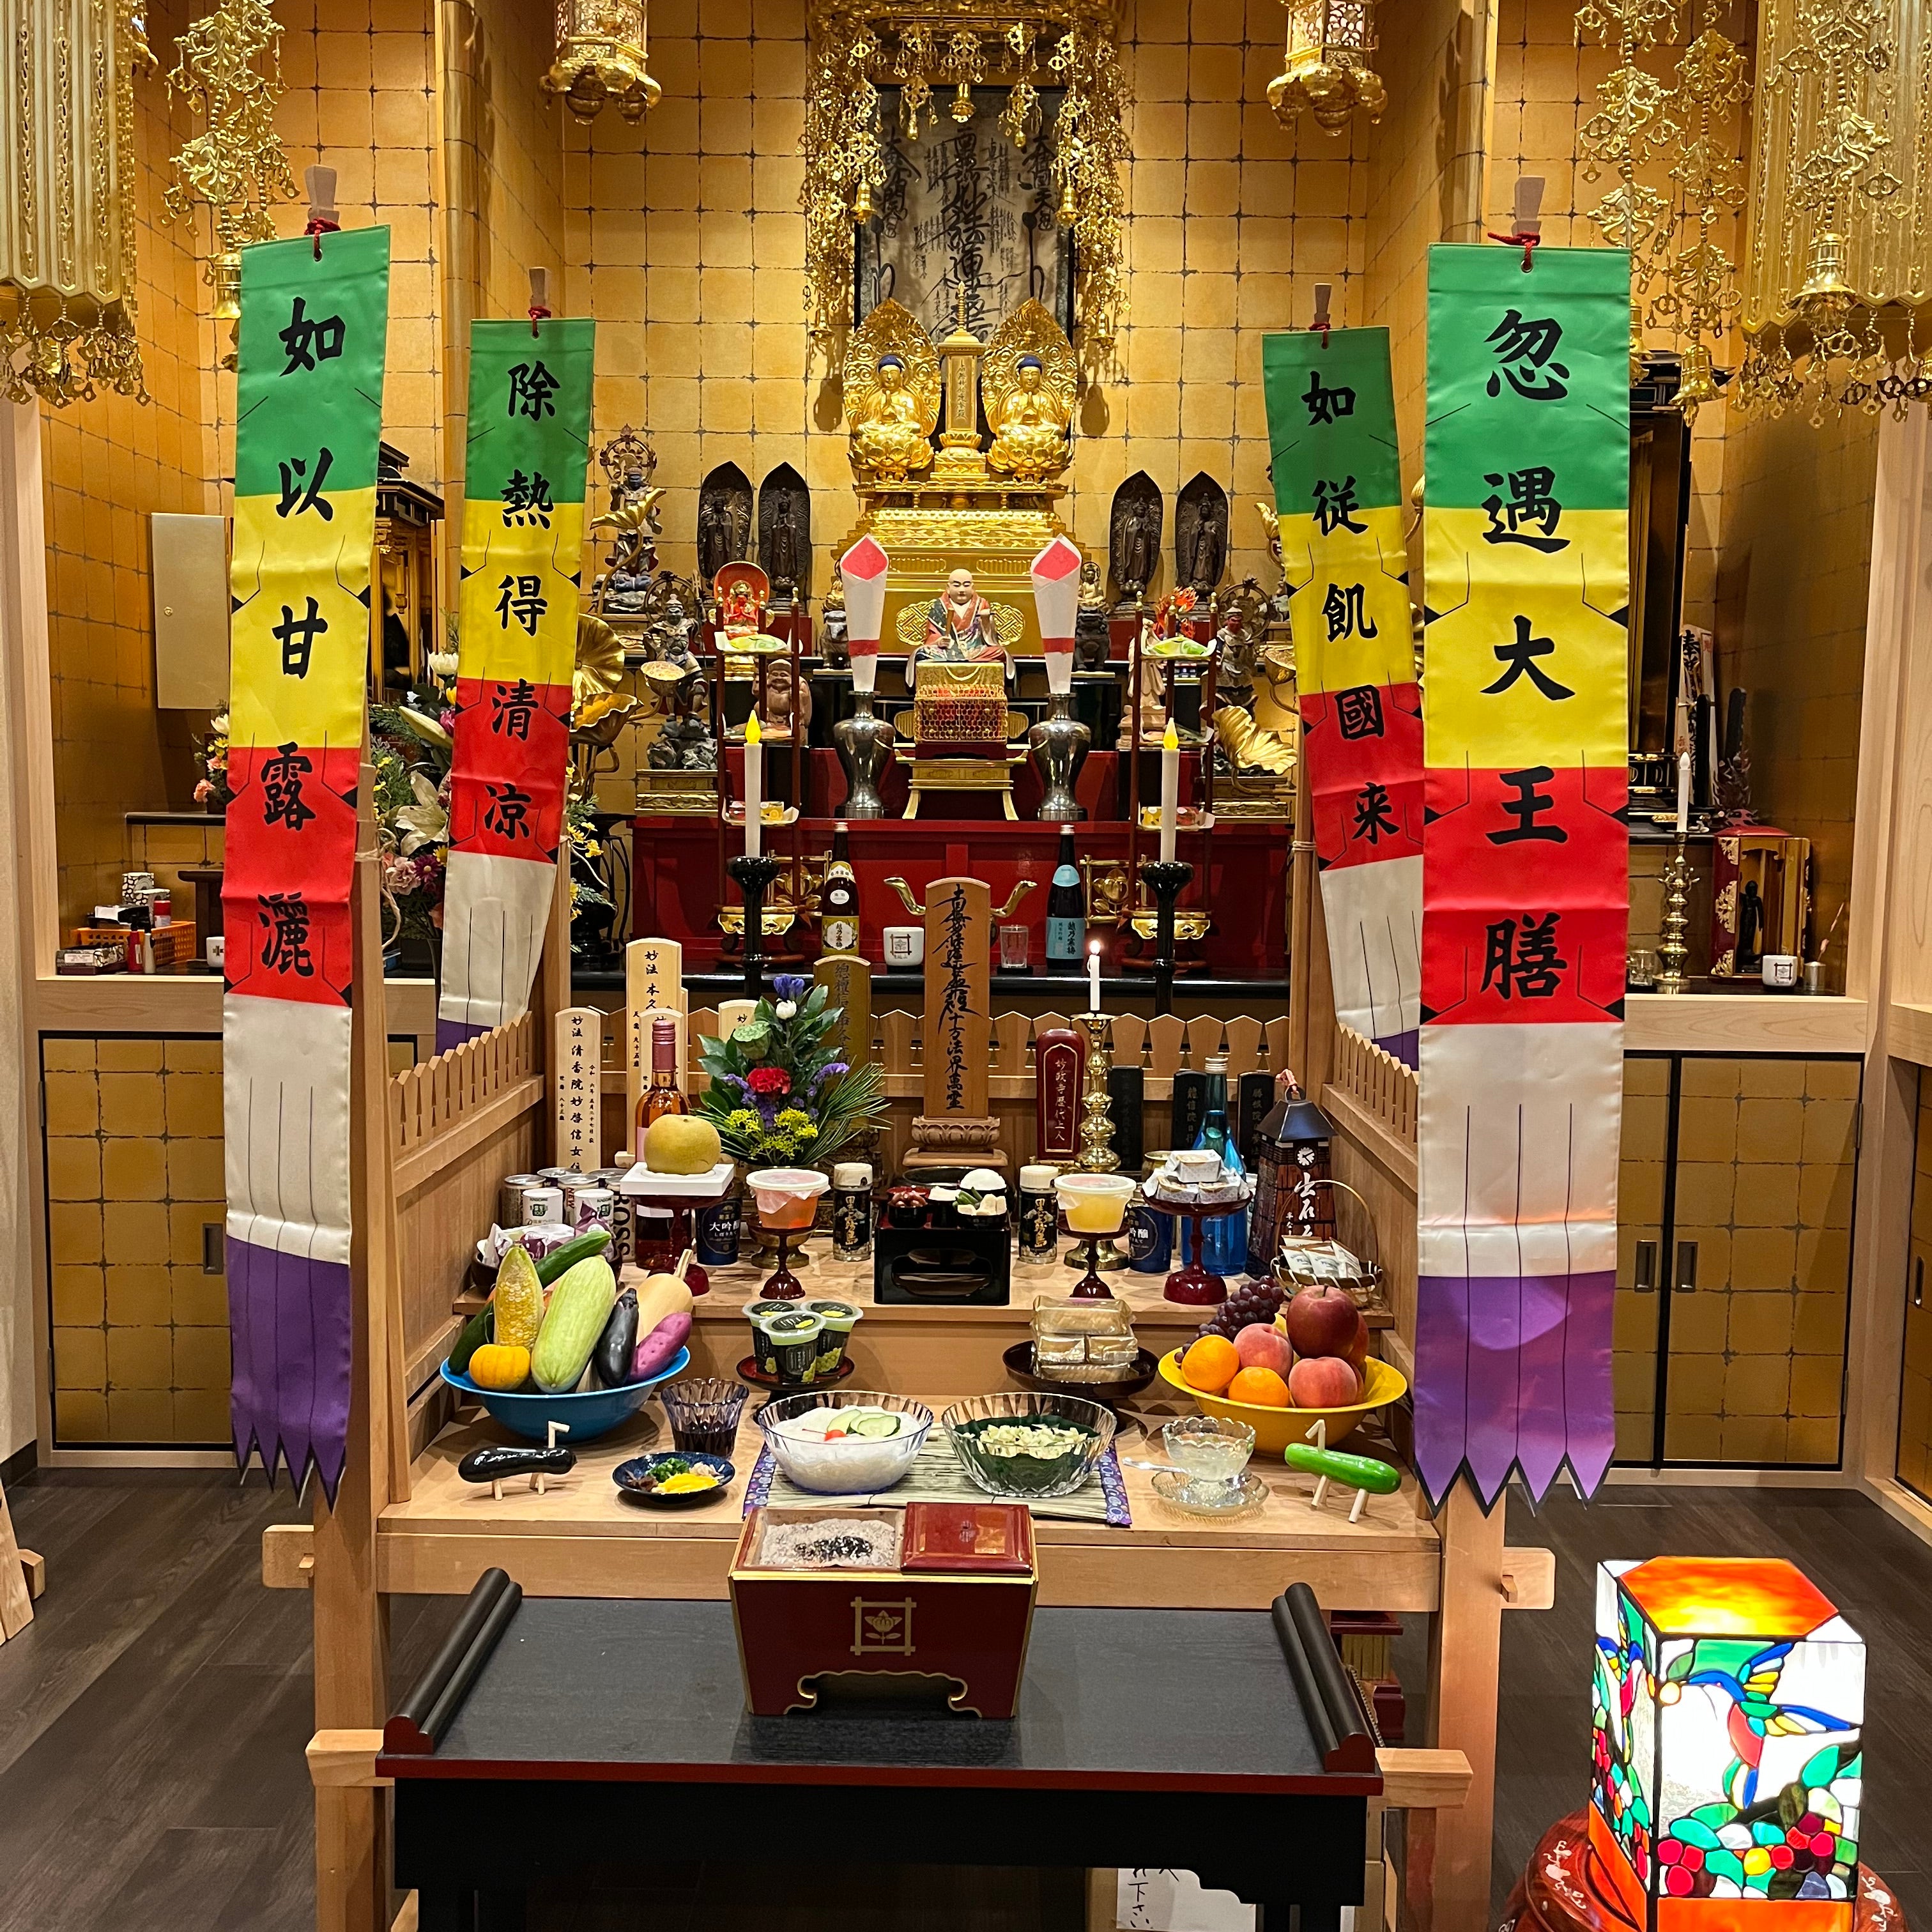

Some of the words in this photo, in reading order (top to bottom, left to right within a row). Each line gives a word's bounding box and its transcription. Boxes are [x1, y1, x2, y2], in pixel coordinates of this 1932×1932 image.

[258, 296, 346, 976] 如以甘露灑
[1480, 309, 1575, 999] 忽遇大王膳
